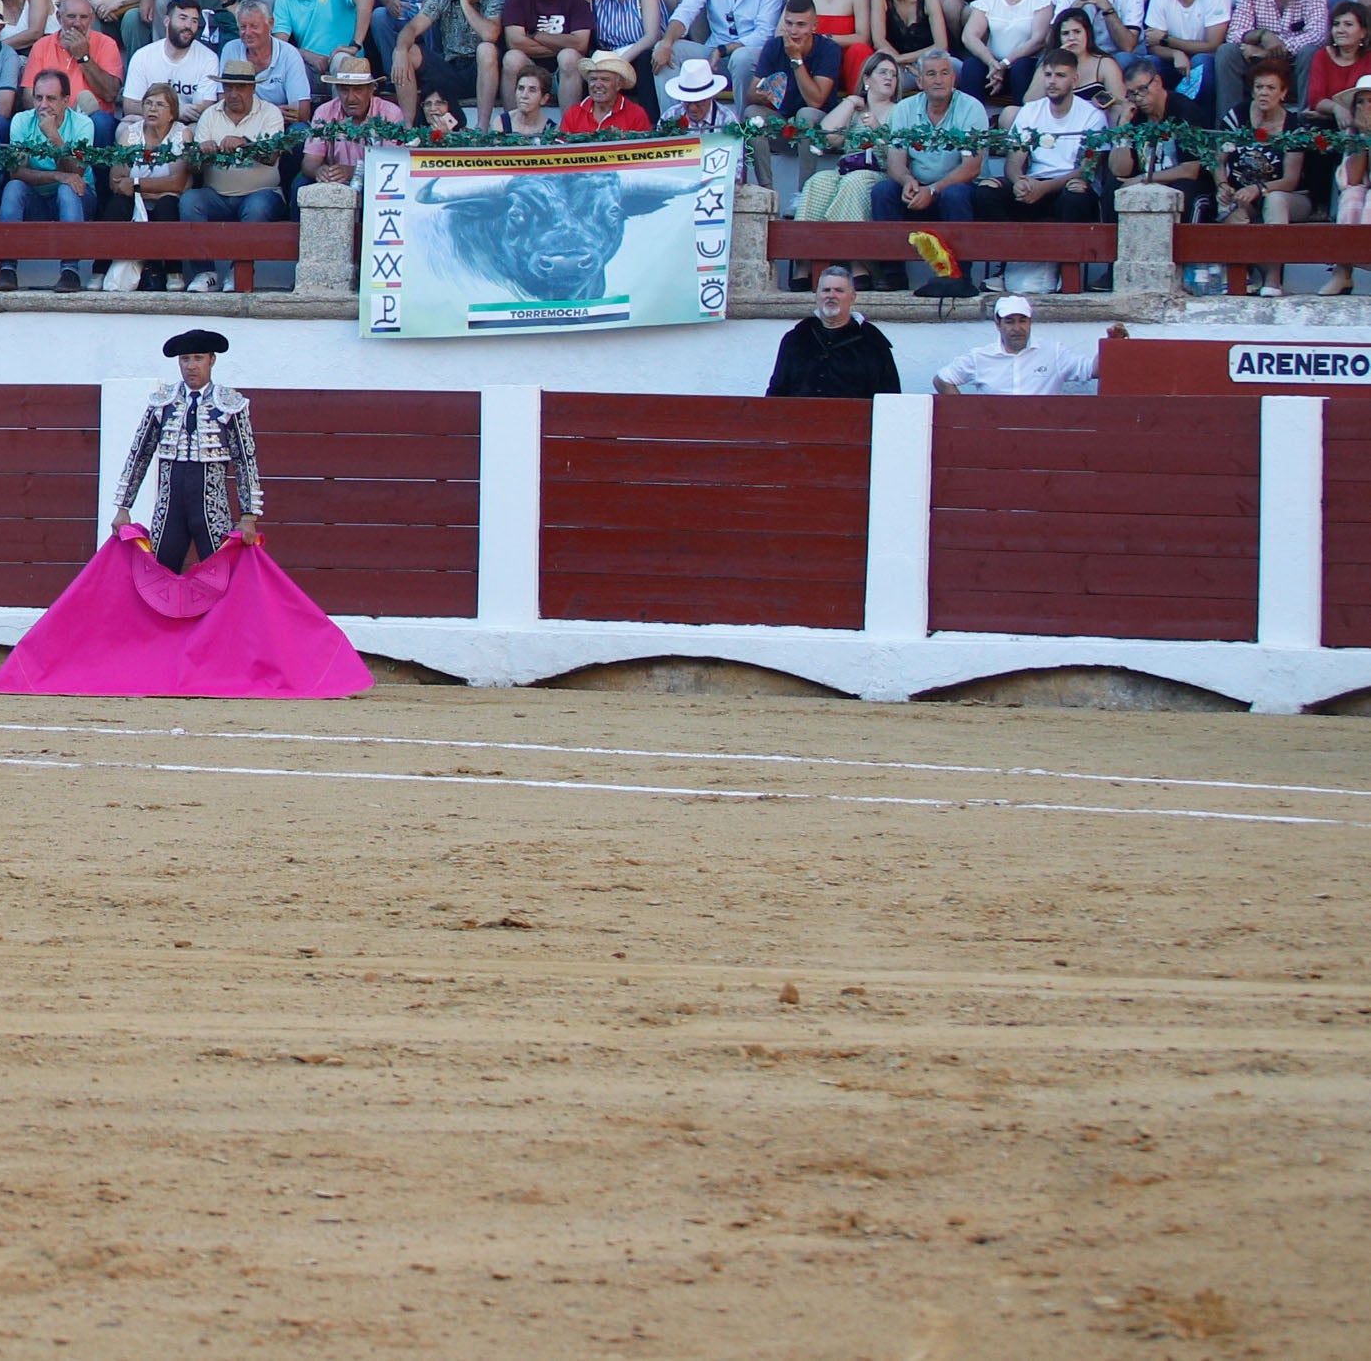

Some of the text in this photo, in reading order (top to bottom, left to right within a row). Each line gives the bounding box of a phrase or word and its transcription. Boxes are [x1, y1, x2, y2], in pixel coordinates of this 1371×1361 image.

[420, 158, 492, 168] ASOCIACIÓN
[494, 158, 554, 167] CULTURAL
[554, 154, 607, 165] TAURINA
[510, 308, 589, 319] TORREMOCHA
[1236, 352, 1371, 377] ARENERO
